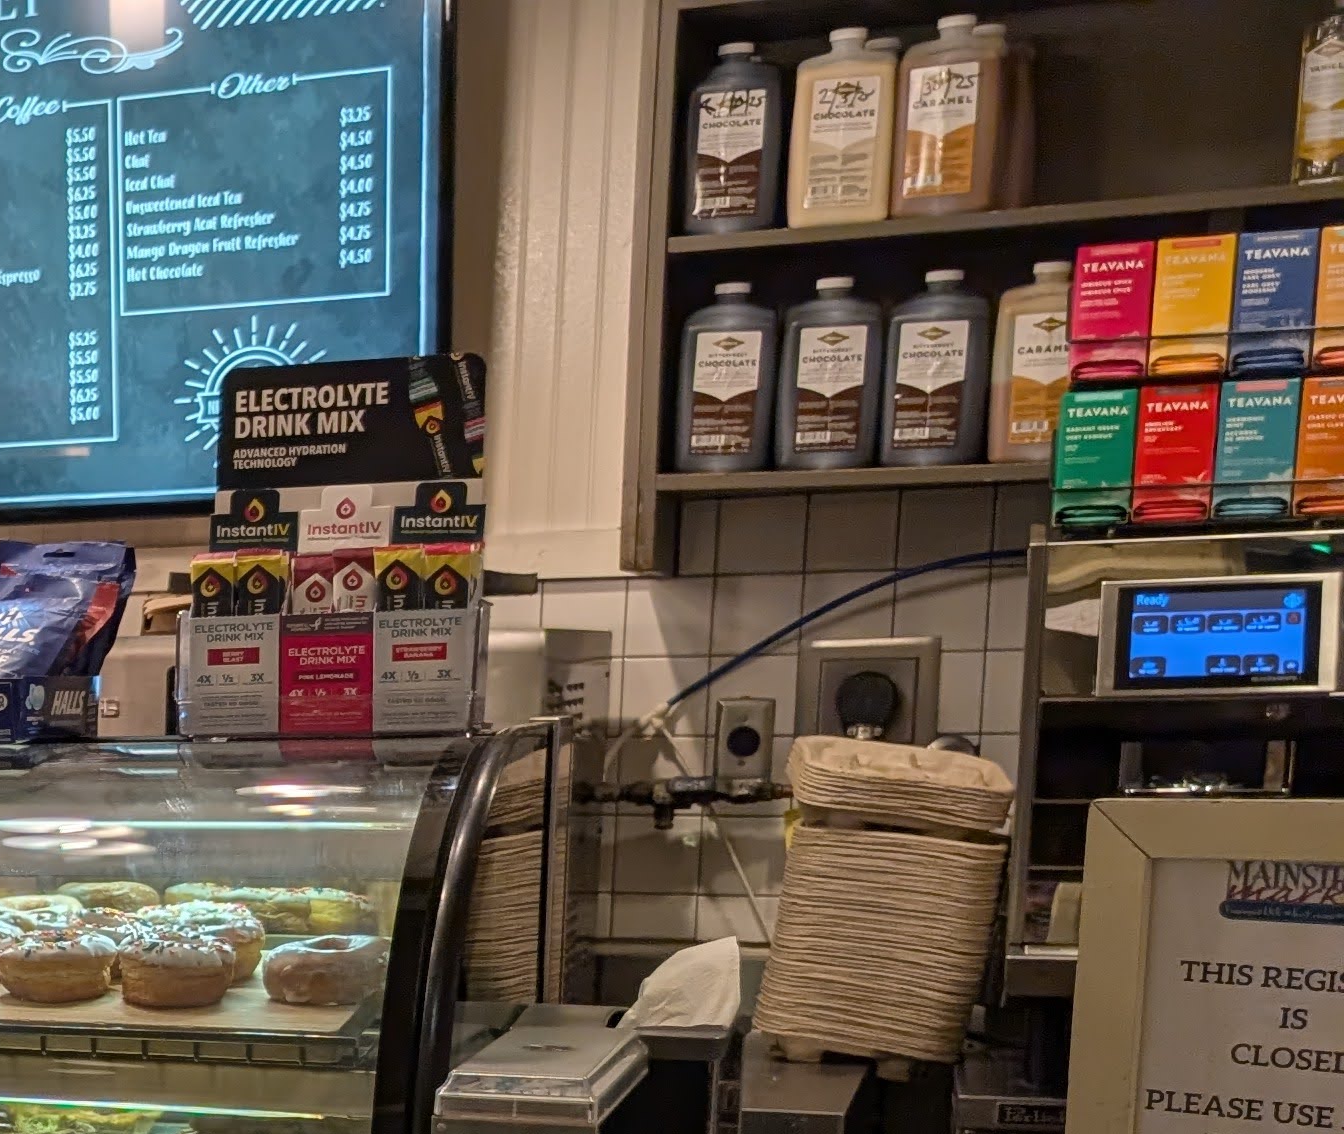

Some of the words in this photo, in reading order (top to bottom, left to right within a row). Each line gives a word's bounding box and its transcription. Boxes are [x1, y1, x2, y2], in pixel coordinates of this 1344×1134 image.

[218, 73, 291, 99] Other
[813, 111, 875, 120] CHOCOLATE
[66, 127, 96, 146] $5.50
[125, 130, 145, 146] Hot
[148, 129, 168, 144] Tea
[340, 130, 373, 150] $4.50
[66, 146, 96, 166] $5.50
[125, 155, 151, 169] Chai
[339, 154, 373, 174] $4.50
[66, 166, 97, 185] $5.50
[125, 177, 148, 192] Iced
[150, 174, 177, 189] Chai
[126, 195, 195, 215] Unsweetened
[197, 192, 221, 208] Iced
[223, 191, 244, 205] Tea
[339, 201, 372, 221] $4.75
[127, 221, 191, 237] Strawberry
[194, 217, 218, 232] Acai
[220, 212, 276, 230] Refresher
[339, 225, 372, 245] $4.75
[127, 246, 165, 261] Mango
[168, 242, 210, 259] Dragon
[212, 238, 242, 251] Fruit
[244, 232, 301, 250] Refresher
[1245, 247, 1311, 260] TEAVANA
[339, 248, 372, 268] $4.50
[1082, 259, 1144, 273] TEAVANA
[127, 267, 147, 282] Hot
[150, 263, 205, 281] Chocolate
[69, 281, 97, 300] $2.75
[69, 349, 99, 368] $5.50
[802, 354, 862, 364] CHOCOLATE
[902, 349, 964, 360] CHOCOLATE
[70, 368, 99, 387] $5.50
[235, 382, 390, 413] ELECTROLYTE
[1146, 400, 1209, 412] TEAVANA
[1068, 406, 1130, 418] TEAVANA
[234, 413, 311, 439] DRINK
[317, 410, 366, 435] MIX
[233, 446, 286, 459] ADVANCED
[289, 444, 346, 456] HYDRATION
[233, 458, 298, 470] TECHNOLOGY
[1137, 593, 1169, 608] Ready
[194, 621, 274, 633] ELECTROLYTE
[378, 617, 462, 629] ELECTROLYTE
[391, 628, 430, 638] DRINK
[432, 627, 452, 636] MIX
[207, 632, 242, 642] DRINK
[244, 631, 264, 641] MIX
[51, 690, 85, 716] HALLS
[1181, 960, 1253, 986] THIS
[1279, 1007, 1308, 1030] IS
[1145, 1089, 1263, 1121] PLEASE
[1273, 1102, 1334, 1128] USE
